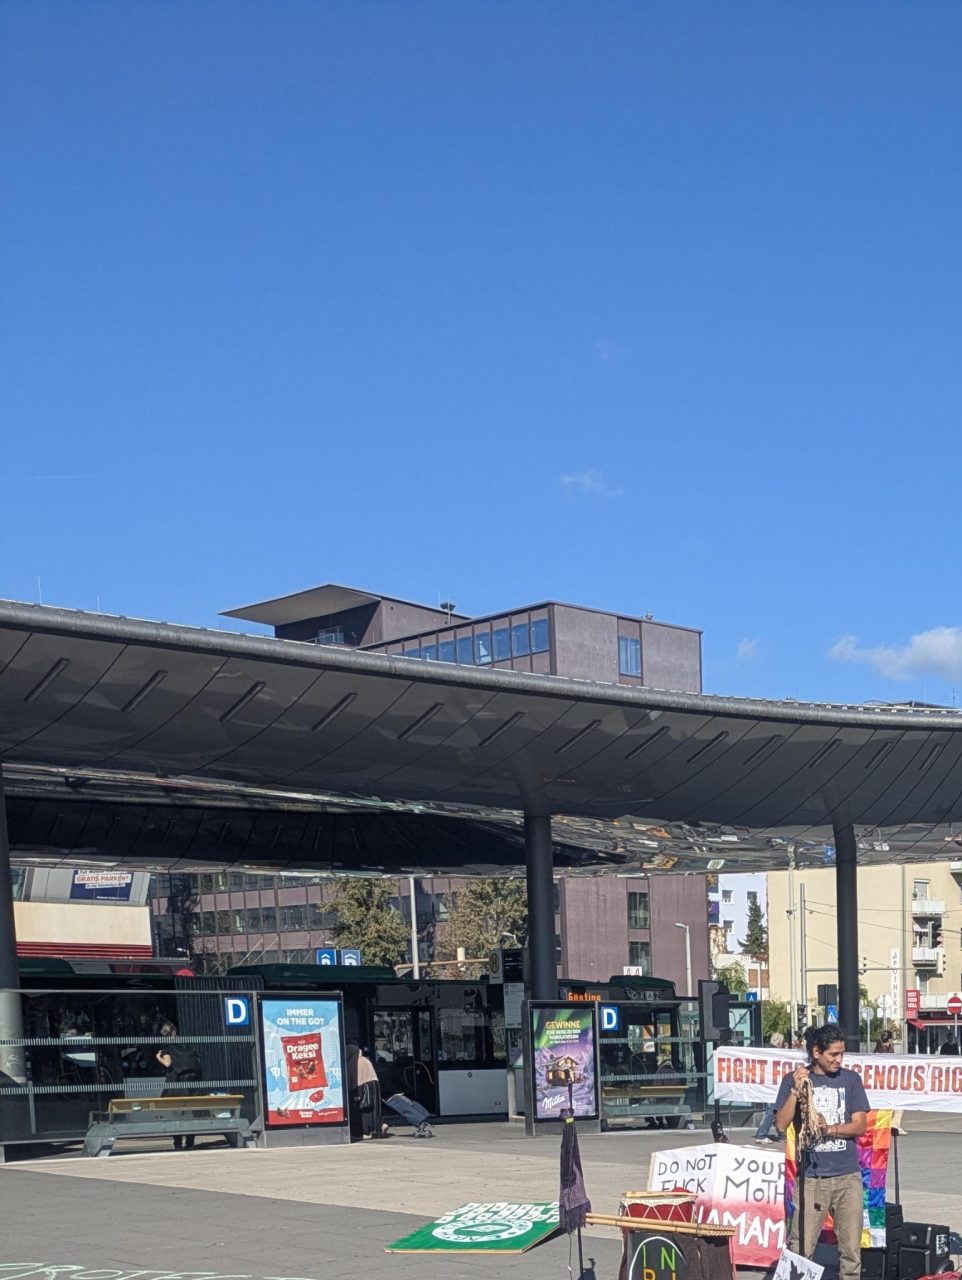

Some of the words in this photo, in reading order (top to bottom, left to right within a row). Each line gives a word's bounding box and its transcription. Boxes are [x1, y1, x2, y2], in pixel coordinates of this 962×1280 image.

[227, 999, 246, 1023] D
[286, 1008, 314, 1017] IMMER
[308, 1017, 325, 1025] GO?
[603, 1008, 617, 1029] D
[545, 1020, 581, 1030] GEWINNE
[286, 1043, 319, 1053] Dragee
[291, 1051, 316, 1060] Keksi
[717, 1057, 768, 1085] FIGHT
[772, 1060, 806, 1085] FO
[657, 1161, 679, 1176] DO
[686, 1153, 717, 1172] NOT
